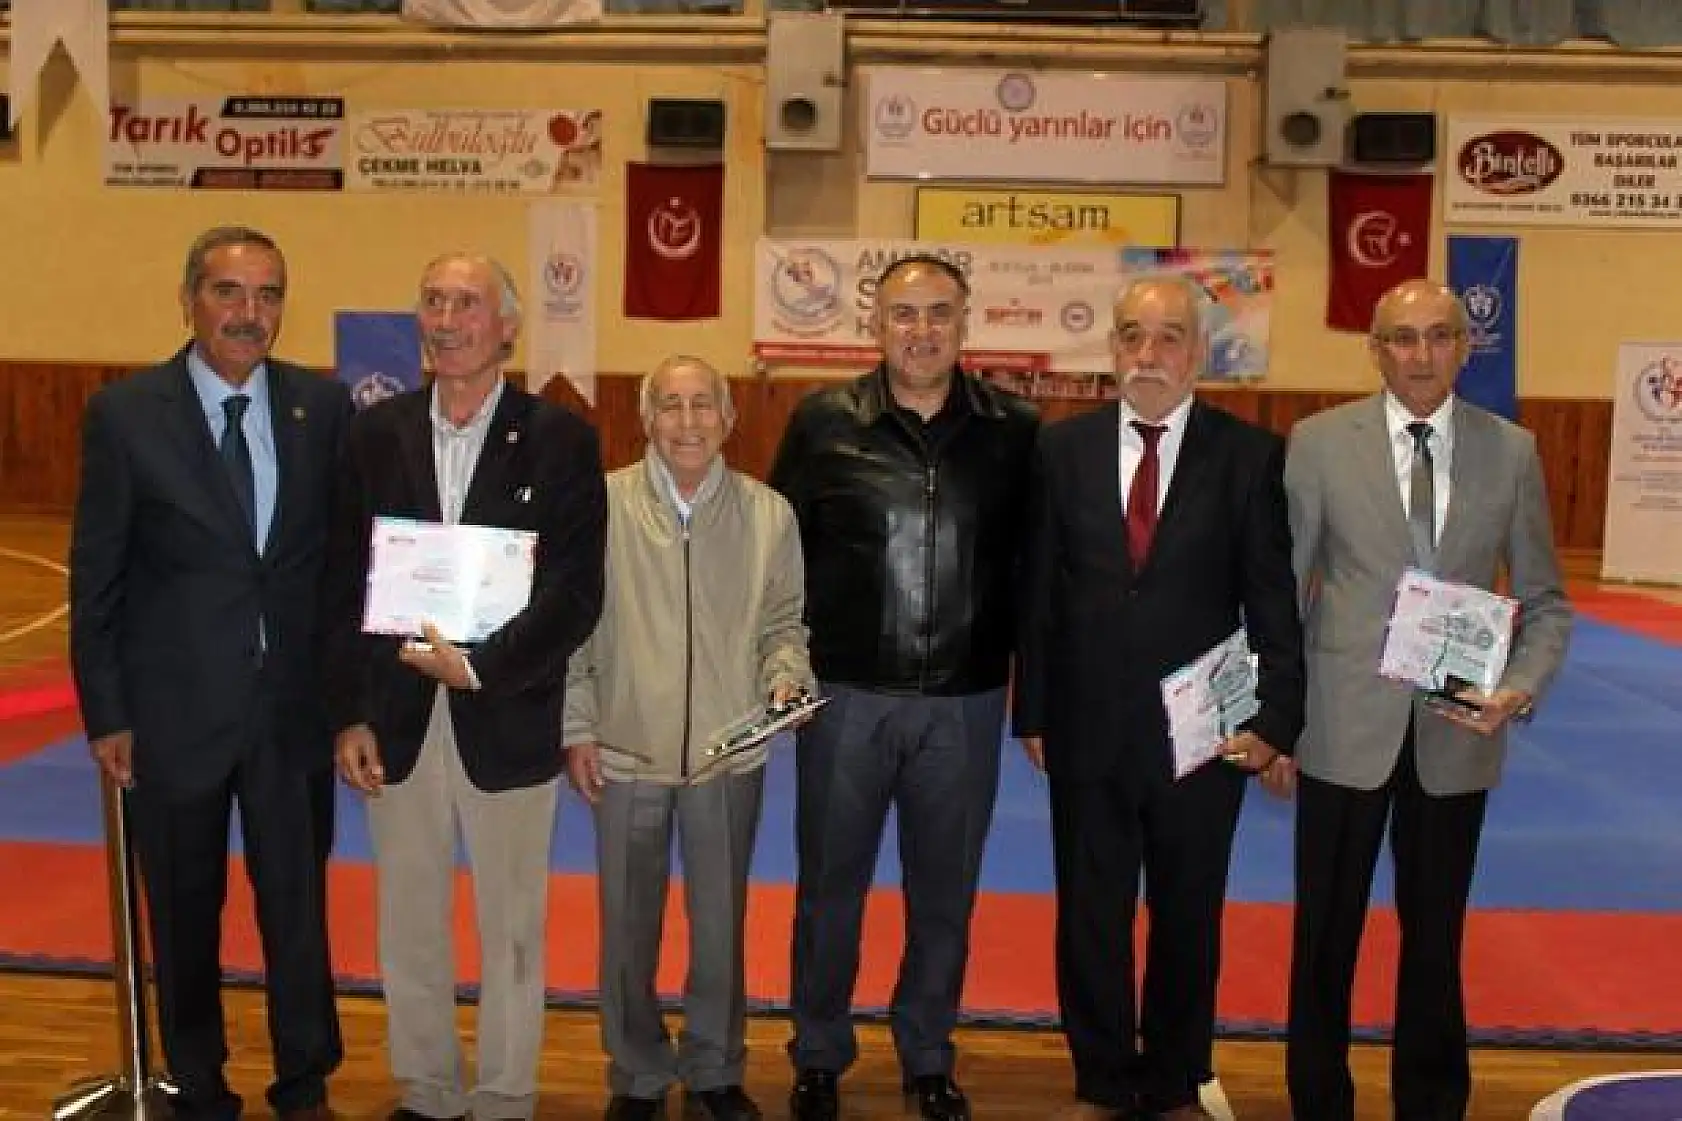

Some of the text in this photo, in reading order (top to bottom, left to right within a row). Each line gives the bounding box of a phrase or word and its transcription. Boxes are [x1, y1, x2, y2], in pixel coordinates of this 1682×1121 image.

[108, 104, 211, 142] Tarık
[921, 107, 1002, 138] Güçlü
[1007, 110, 1117, 142] yarınlar
[426, 157, 483, 175] HELVA
[959, 196, 1111, 229] artsam
